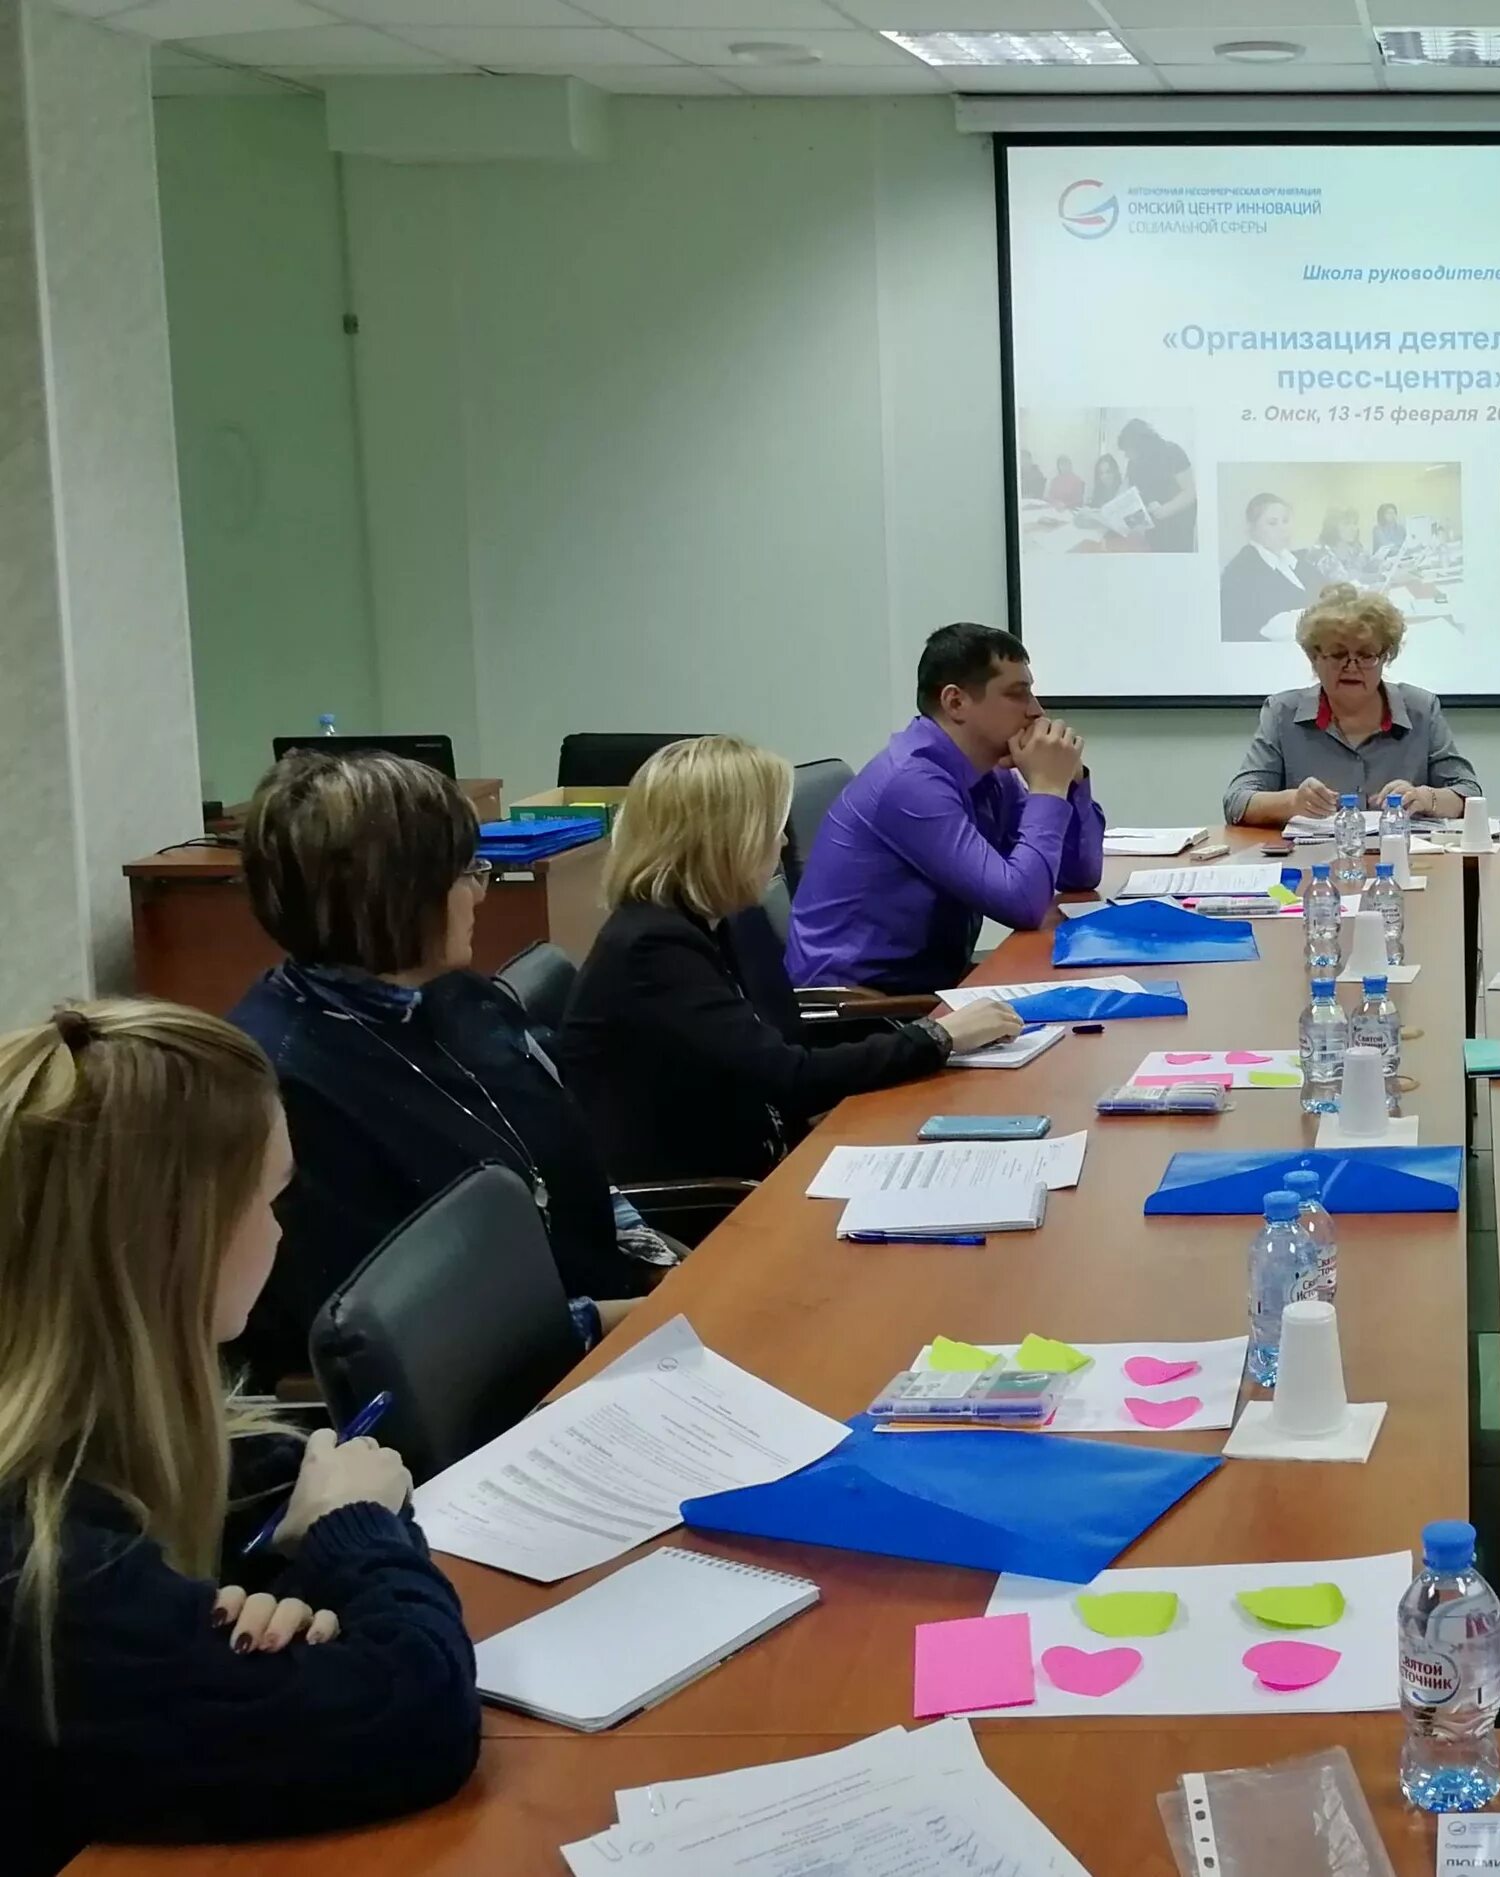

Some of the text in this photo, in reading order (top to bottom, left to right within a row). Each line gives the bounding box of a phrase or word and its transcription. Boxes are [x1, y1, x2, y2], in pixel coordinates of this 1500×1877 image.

[1128, 200, 1322, 216] ОМСКИЙ ЦЕНТР ИННОВАЦИЙ
[1128, 219, 1267, 234] СОЦИАЛЬНОЙ СФЕРЫ
[1303, 265, 1363, 281] Школа
[1162, 324, 1392, 355] «Организация
[1241, 407, 1257, 422] г.
[1264, 405, 1321, 424] Омск,
[1328, 405, 1350, 422] 13
[1389, 405, 1478, 425] февраля
